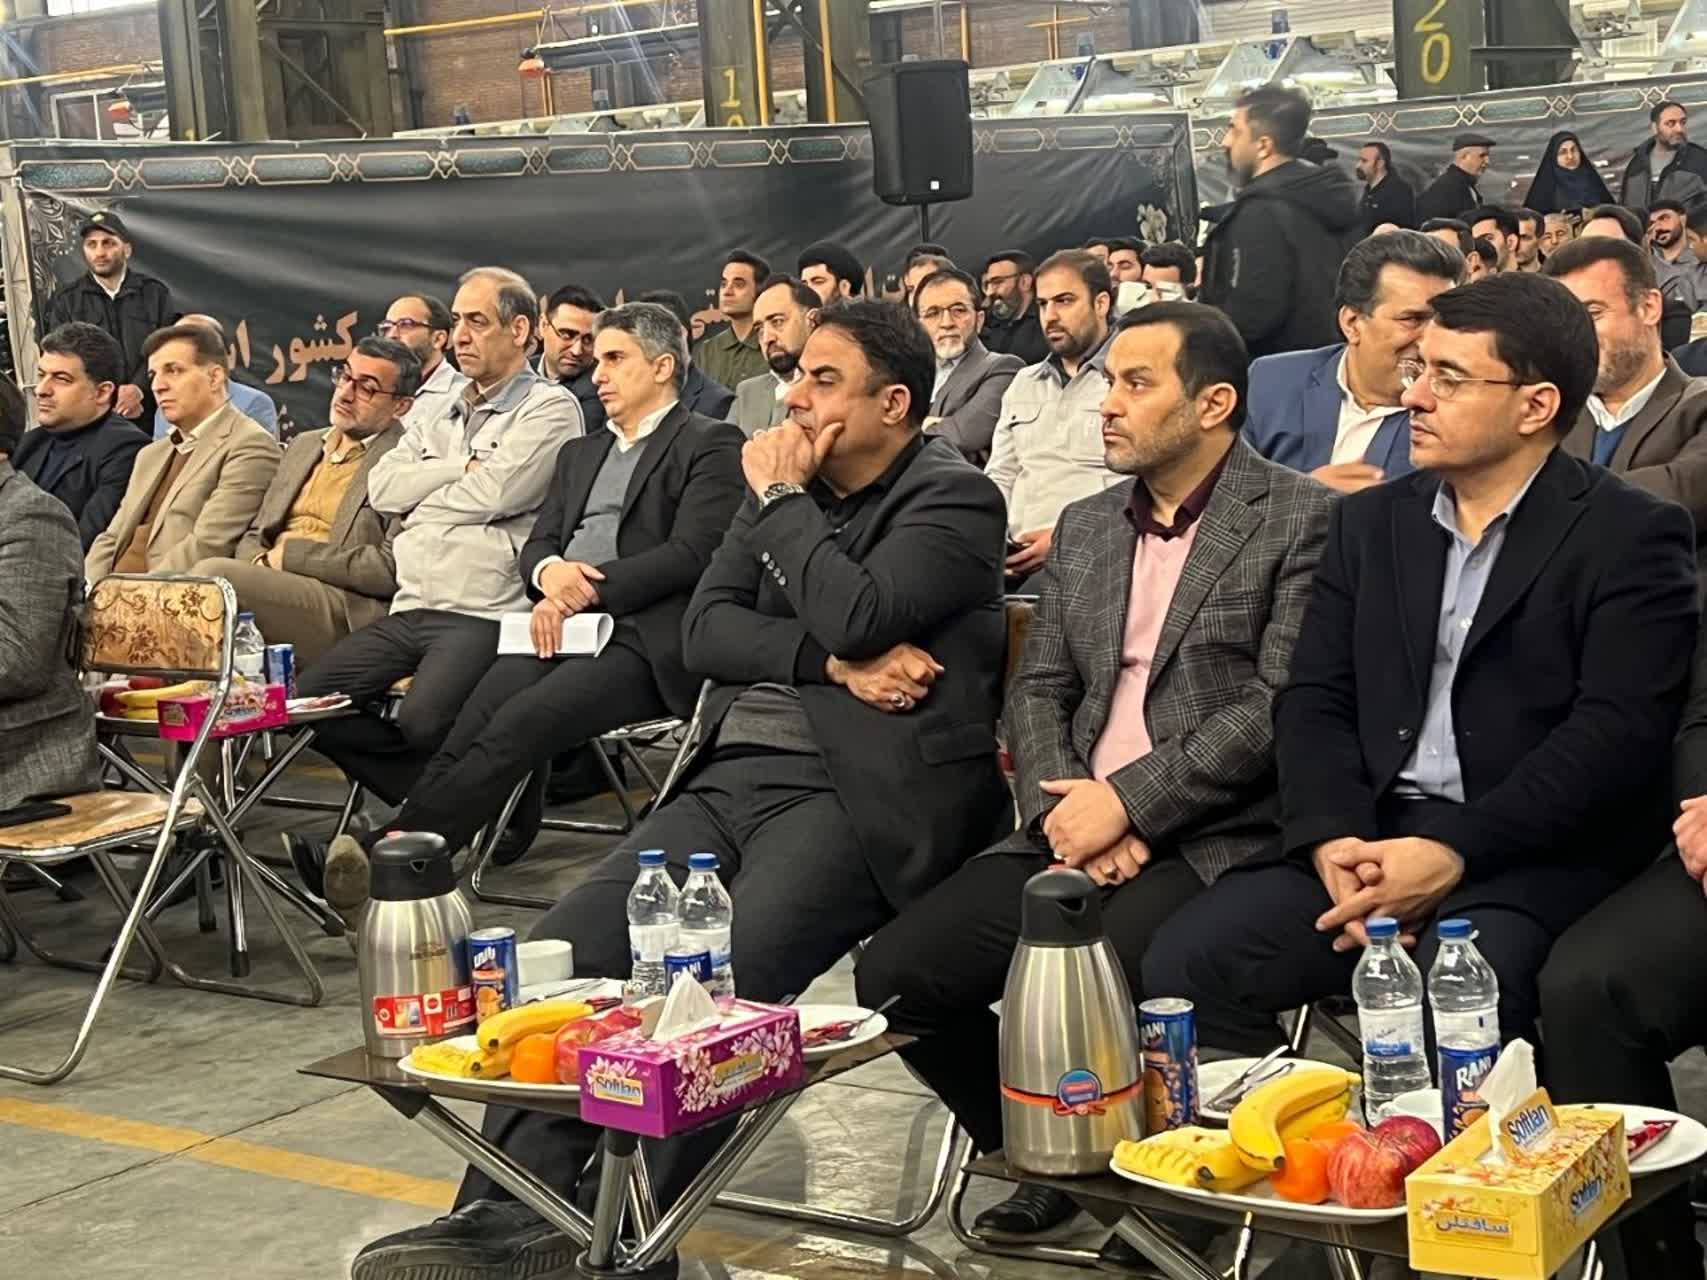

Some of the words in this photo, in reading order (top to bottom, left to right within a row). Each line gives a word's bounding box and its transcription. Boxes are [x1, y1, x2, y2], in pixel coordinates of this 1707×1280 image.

[719, 66, 745, 127] 1
[264, 311, 359, 385] کشور
[1507, 1104, 1550, 1146] Softlan
